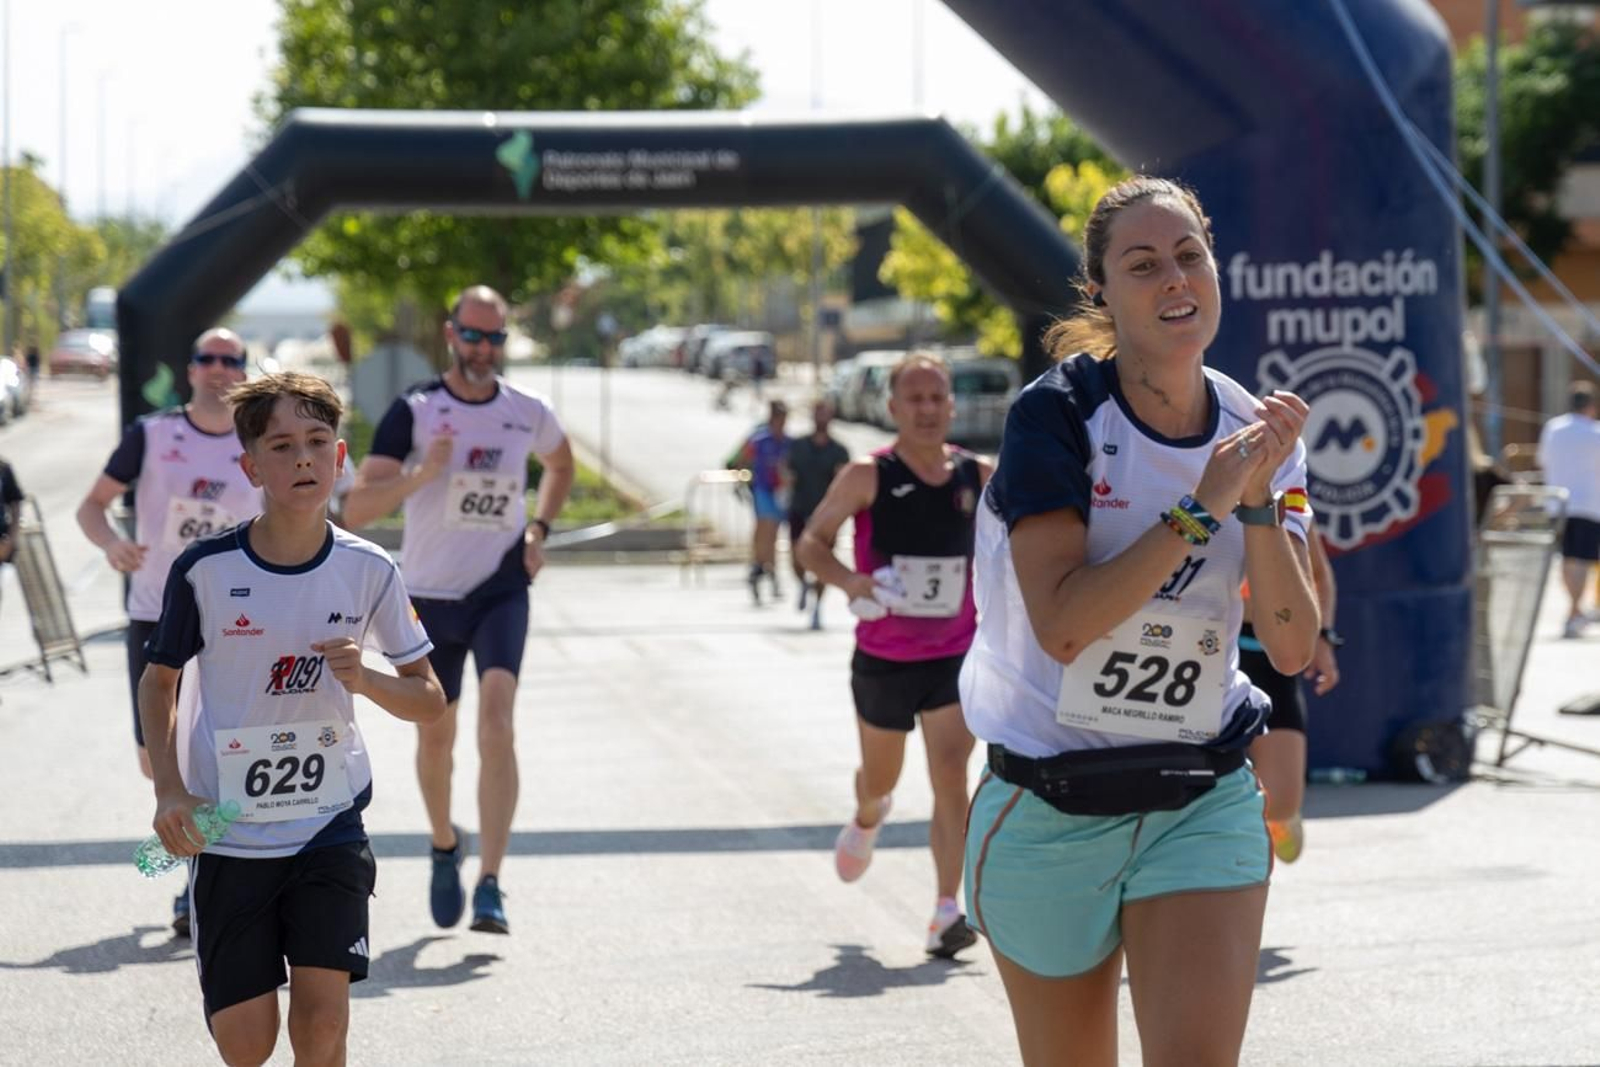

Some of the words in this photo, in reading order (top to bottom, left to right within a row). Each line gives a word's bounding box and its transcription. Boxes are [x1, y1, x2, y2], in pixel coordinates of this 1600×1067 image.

[1229, 249, 1437, 299] fundación
[1267, 297, 1406, 348] mupol
[460, 493, 510, 517] 602
[1091, 498, 1131, 510] tander
[179, 519, 227, 539] 60
[922, 579, 941, 600] 3
[222, 626, 265, 637] Santander
[1093, 650, 1202, 707] 528
[1101, 705, 1122, 716] MACA
[1123, 708, 1158, 721] NEGRILLO
[1158, 713, 1186, 724] RAMIRO
[245, 753, 325, 798] 629
[256, 801, 275, 810] PABLO
[275, 800, 292, 808] MOYA
[292, 797, 319, 807] CARRILLO
